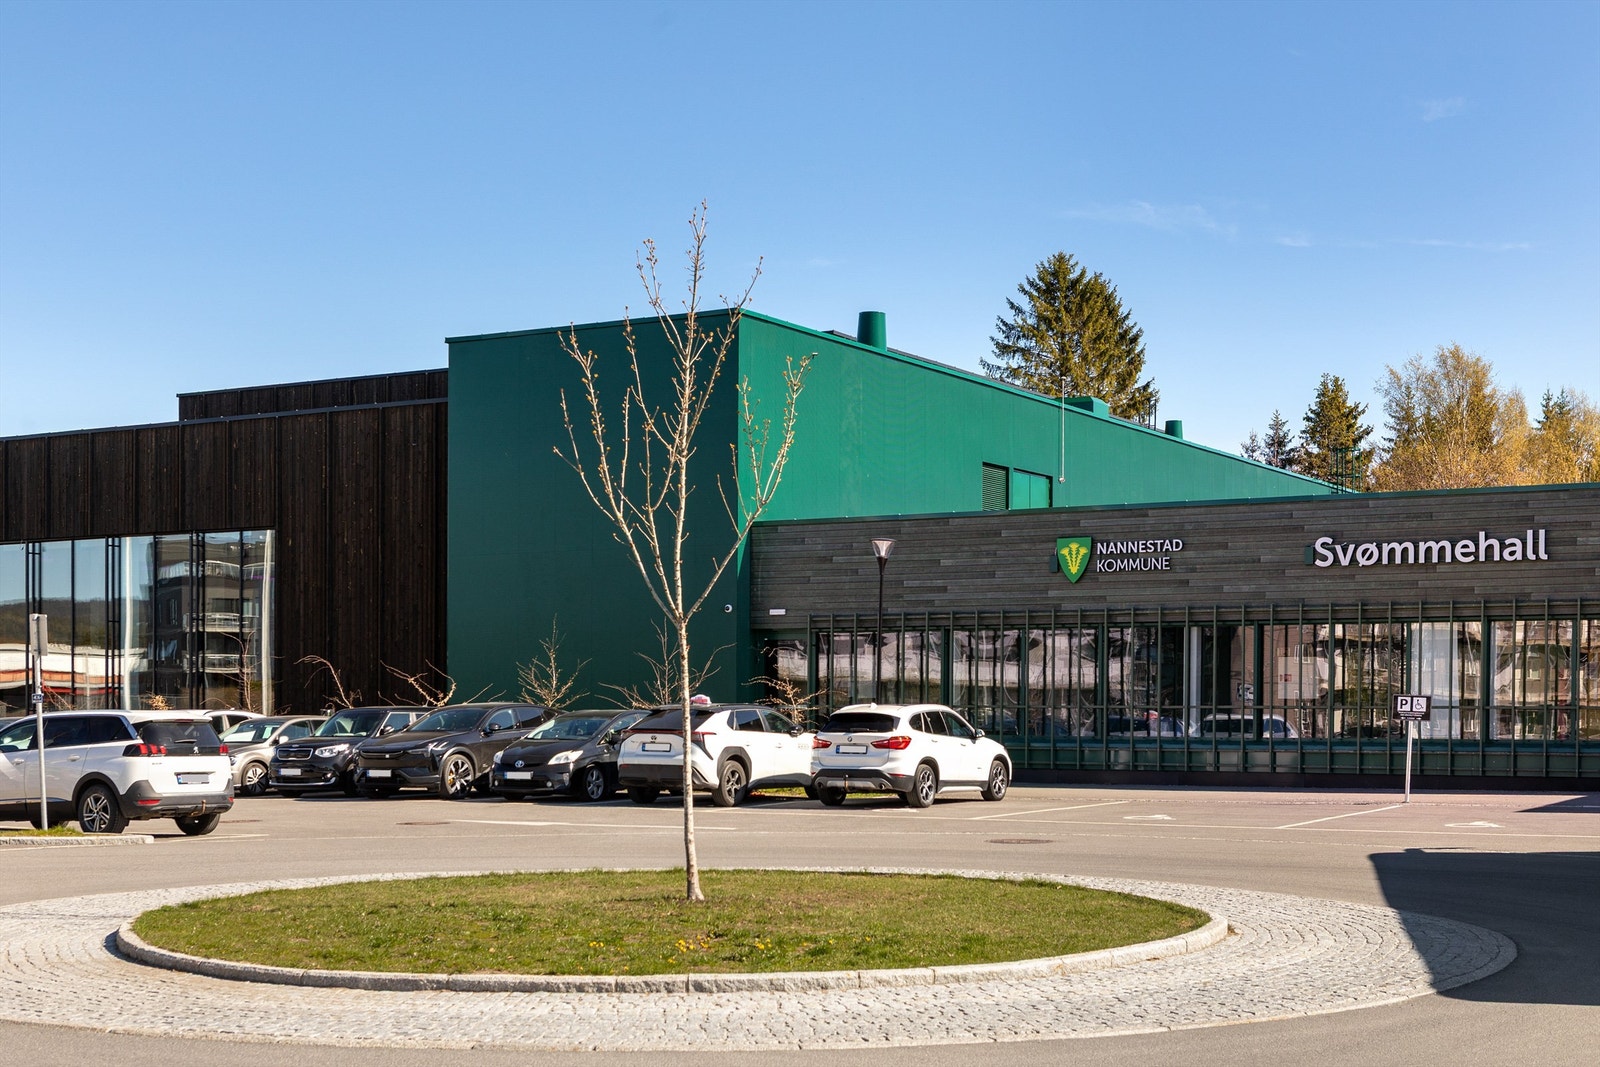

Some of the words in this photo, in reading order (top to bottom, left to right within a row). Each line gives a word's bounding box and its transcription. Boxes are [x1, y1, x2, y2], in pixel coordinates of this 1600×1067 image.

[1096, 539, 1183, 555] NANNESTAD
[1314, 529, 1548, 567] Svømmehall
[1096, 556, 1171, 573] KOMMUNE
[1400, 698, 1409, 710] P
